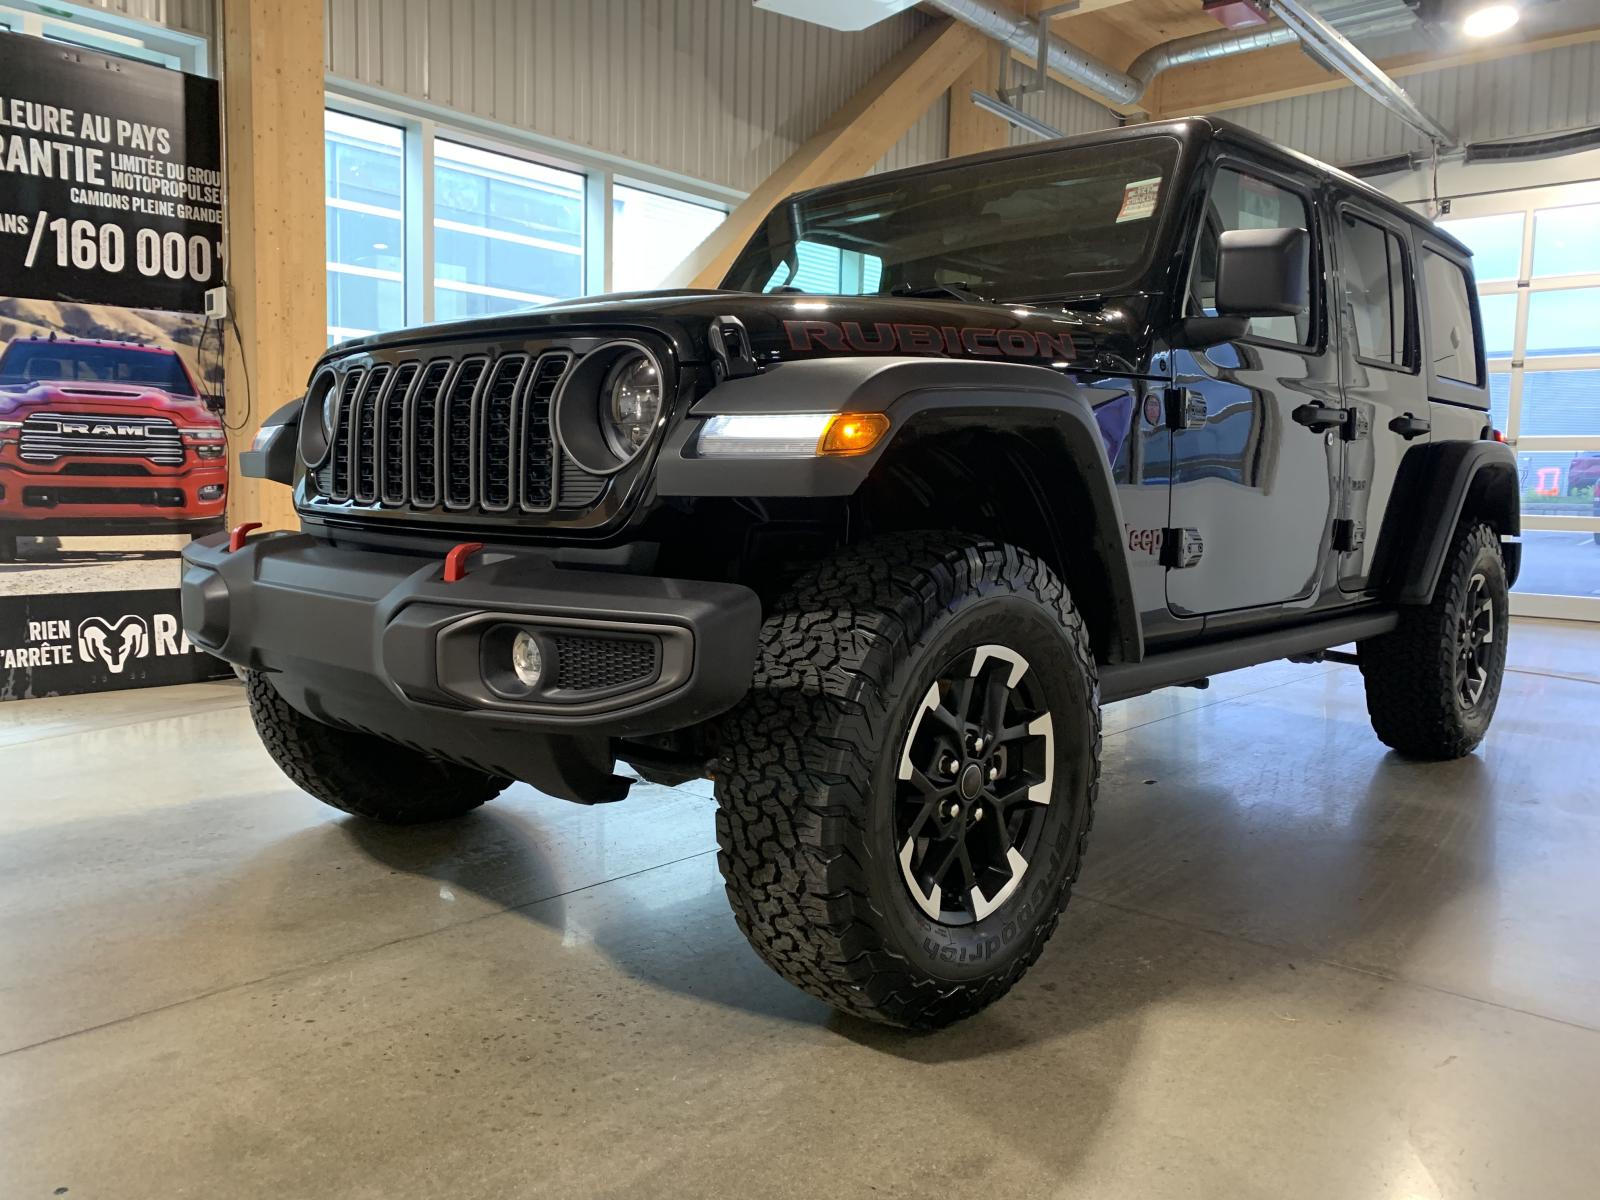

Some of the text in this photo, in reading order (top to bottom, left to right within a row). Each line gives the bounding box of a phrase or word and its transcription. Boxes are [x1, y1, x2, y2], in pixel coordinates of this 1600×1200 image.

[81, 113, 111, 144] AU
[117, 119, 170, 154] PAYS
[111, 152, 221, 187] LIMITÉE DU GROU
[70, 188, 222, 224] CAMIONS PLEINE GRANDE
[136, 228, 211, 282] 000
[783, 320, 1077, 358] RUBICON
[62, 423, 144, 436] RAM
[29, 619, 71, 641] RIEN
